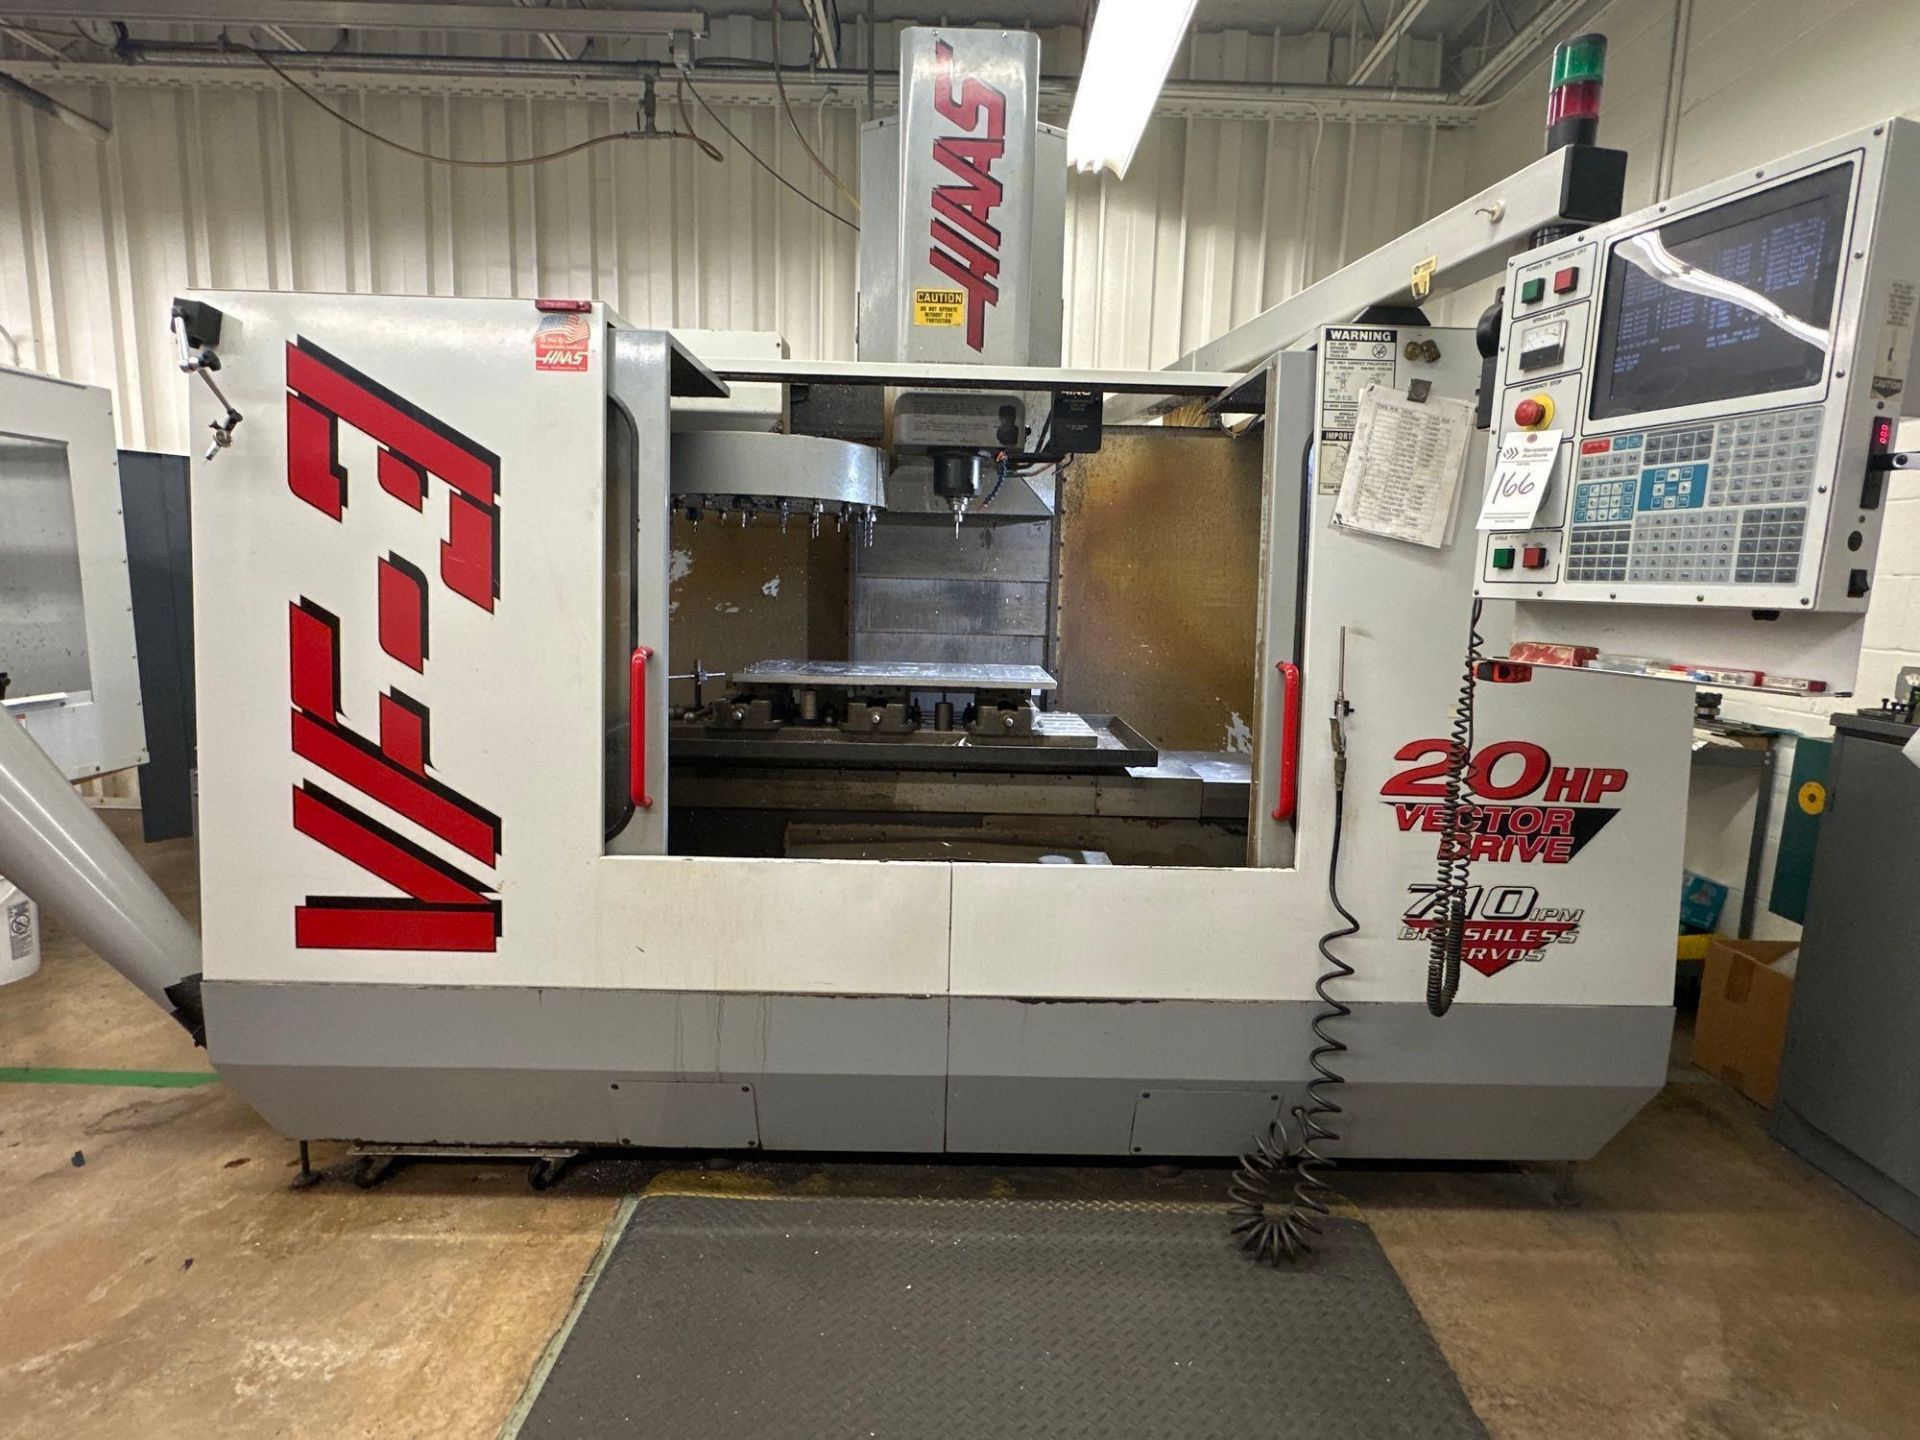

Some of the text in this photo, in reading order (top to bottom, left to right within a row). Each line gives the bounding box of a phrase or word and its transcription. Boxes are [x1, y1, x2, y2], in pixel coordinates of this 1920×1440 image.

[930, 38, 1006, 353] HAAS
[917, 292, 962, 303] CAUTION
[1330, 330, 1392, 341] WARNING
[539, 350, 588, 366] HAAS
[1492, 472, 1535, 505] 166
[286, 335, 502, 952] VF-3
[1394, 803, 1576, 835] VECTOR
